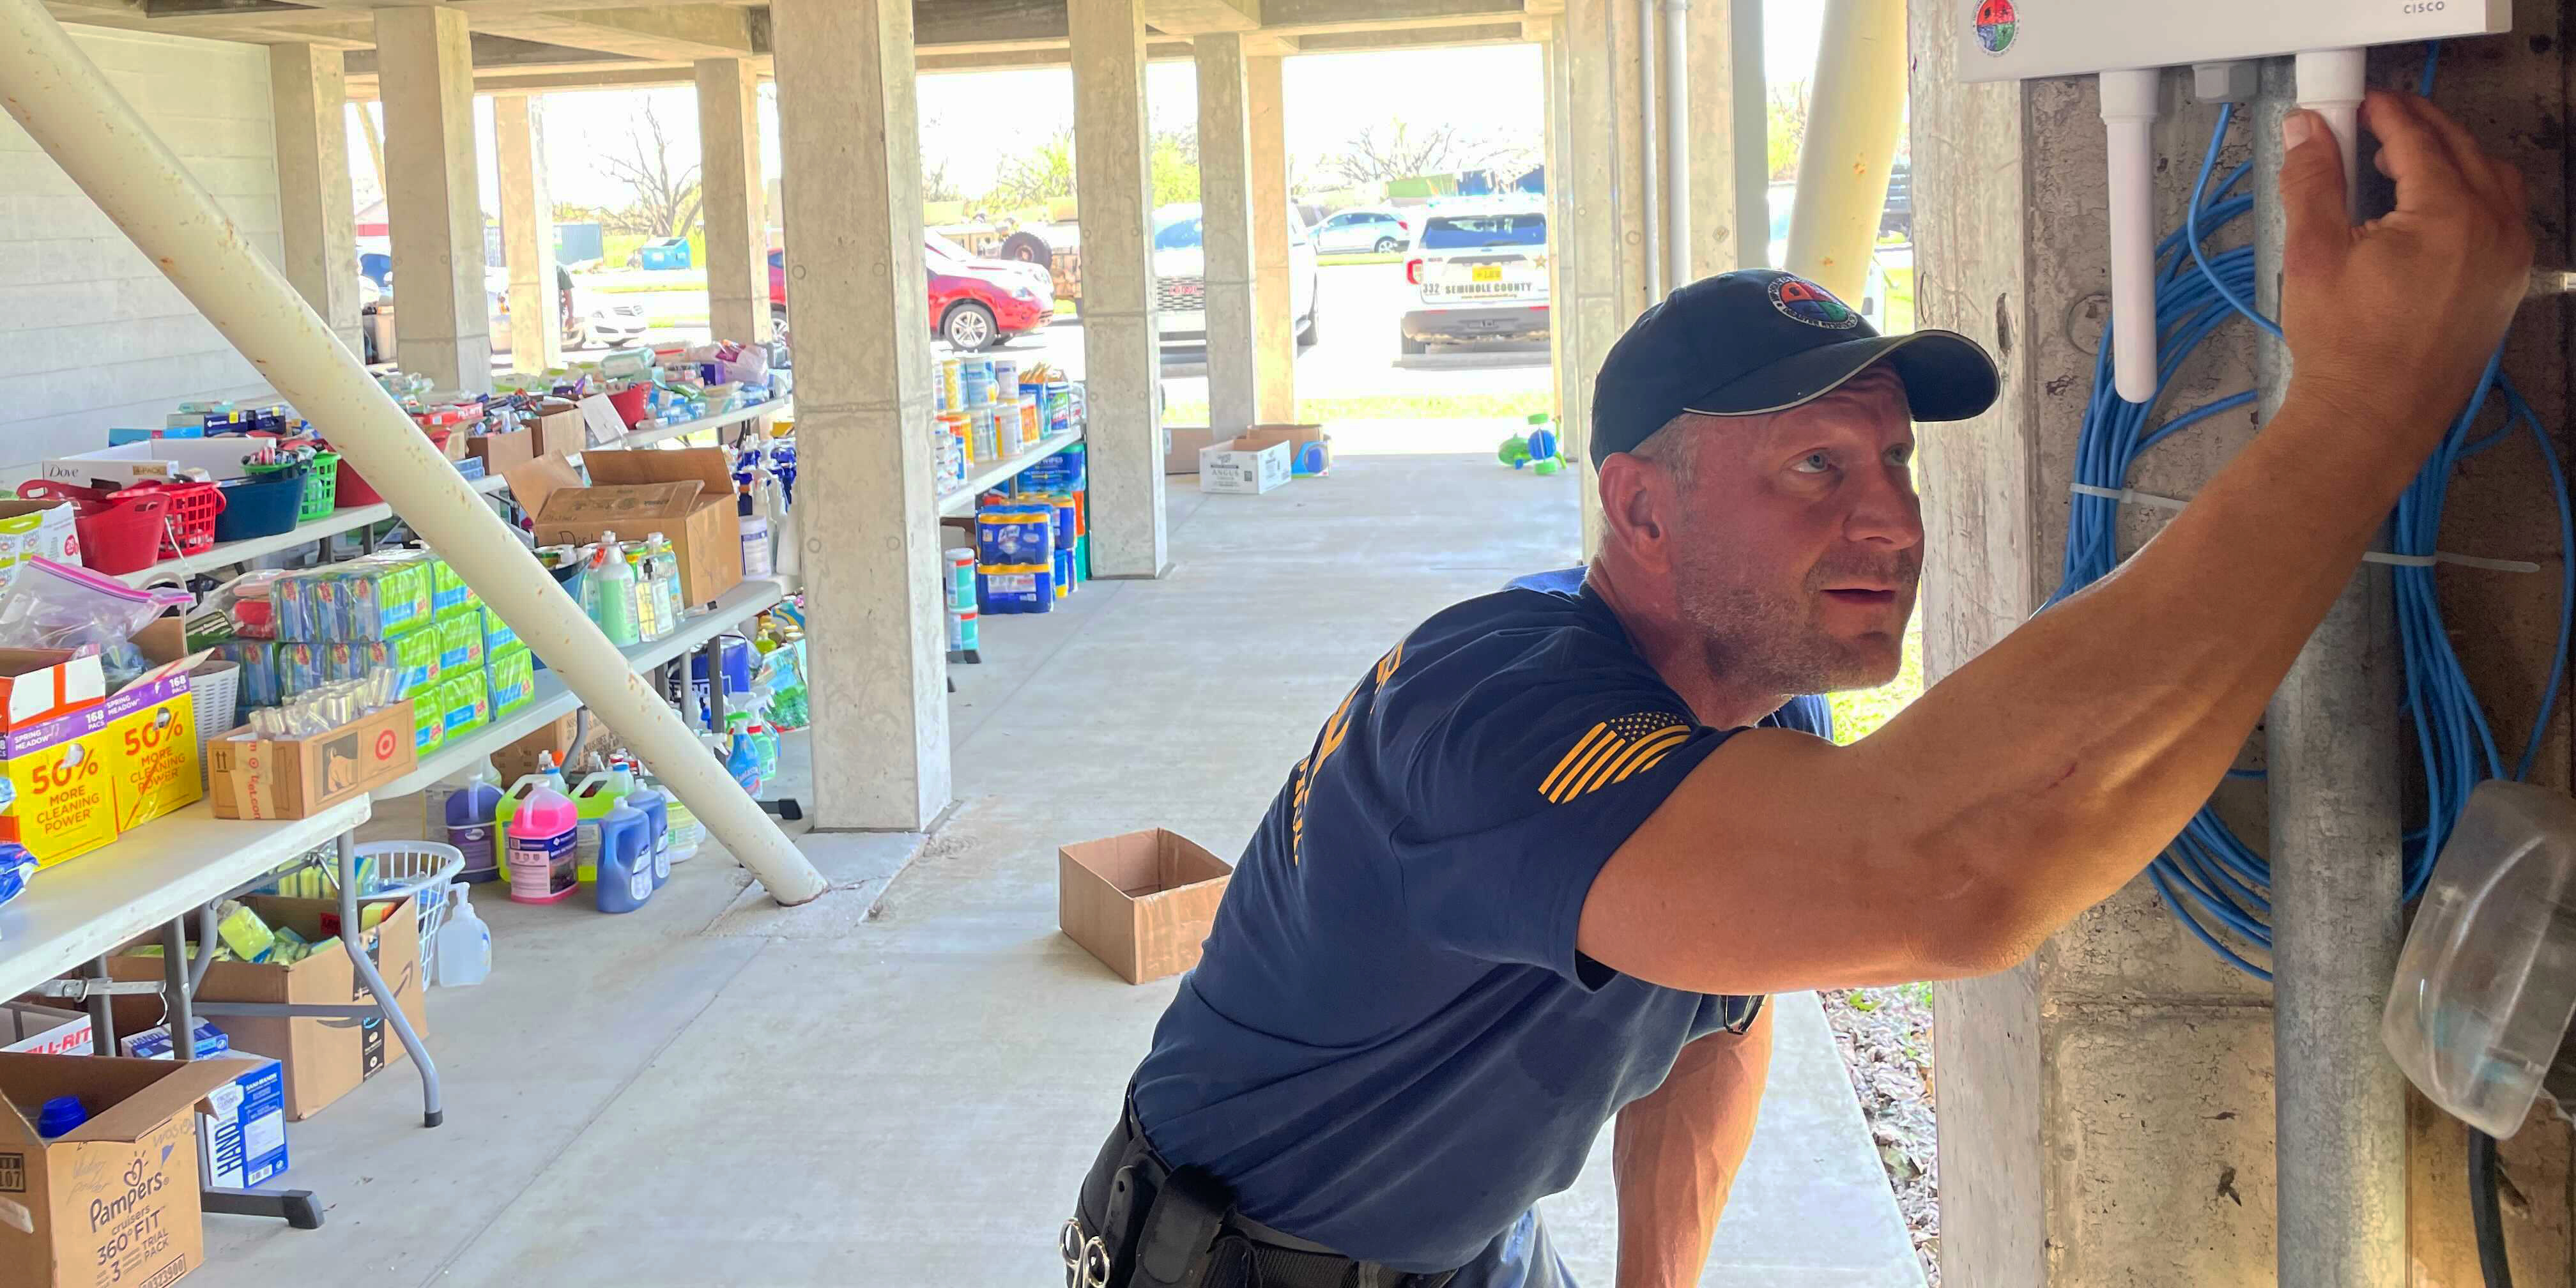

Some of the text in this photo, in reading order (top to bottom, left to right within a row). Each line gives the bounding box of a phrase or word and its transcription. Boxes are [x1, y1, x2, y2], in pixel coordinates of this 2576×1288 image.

[2404, 1, 2444, 14] CISCO
[1423, 282, 1531, 295] 332 SEMINOLE COUNTY
[49, 464, 78, 477] Dove
[169, 675, 187, 688] 168
[171, 685, 187, 694] PACS
[107, 695, 131, 709] SPRING
[108, 700, 139, 716] MEADOW
[86, 710, 104, 724] 168
[88, 720, 105, 730] PACS
[14, 730, 42, 744] SPRING
[15, 735, 49, 751] MEADOW
[142, 746, 173, 767] MORE
[130, 753, 185, 783] CLEANING
[138, 769, 179, 792] POWER
[50, 785, 86, 807] MORE
[37, 793, 100, 824] CLEANING
[45, 809, 91, 834] POWER
[215, 1122, 243, 1177] HAND
[89, 1170, 163, 1234] Pampers
[111, 1205, 151, 1236] cruisers
[142, 1227, 169, 1250] TRIAL
[144, 1237, 169, 1262] PACK
[111, 1260, 121, 1283] 3
